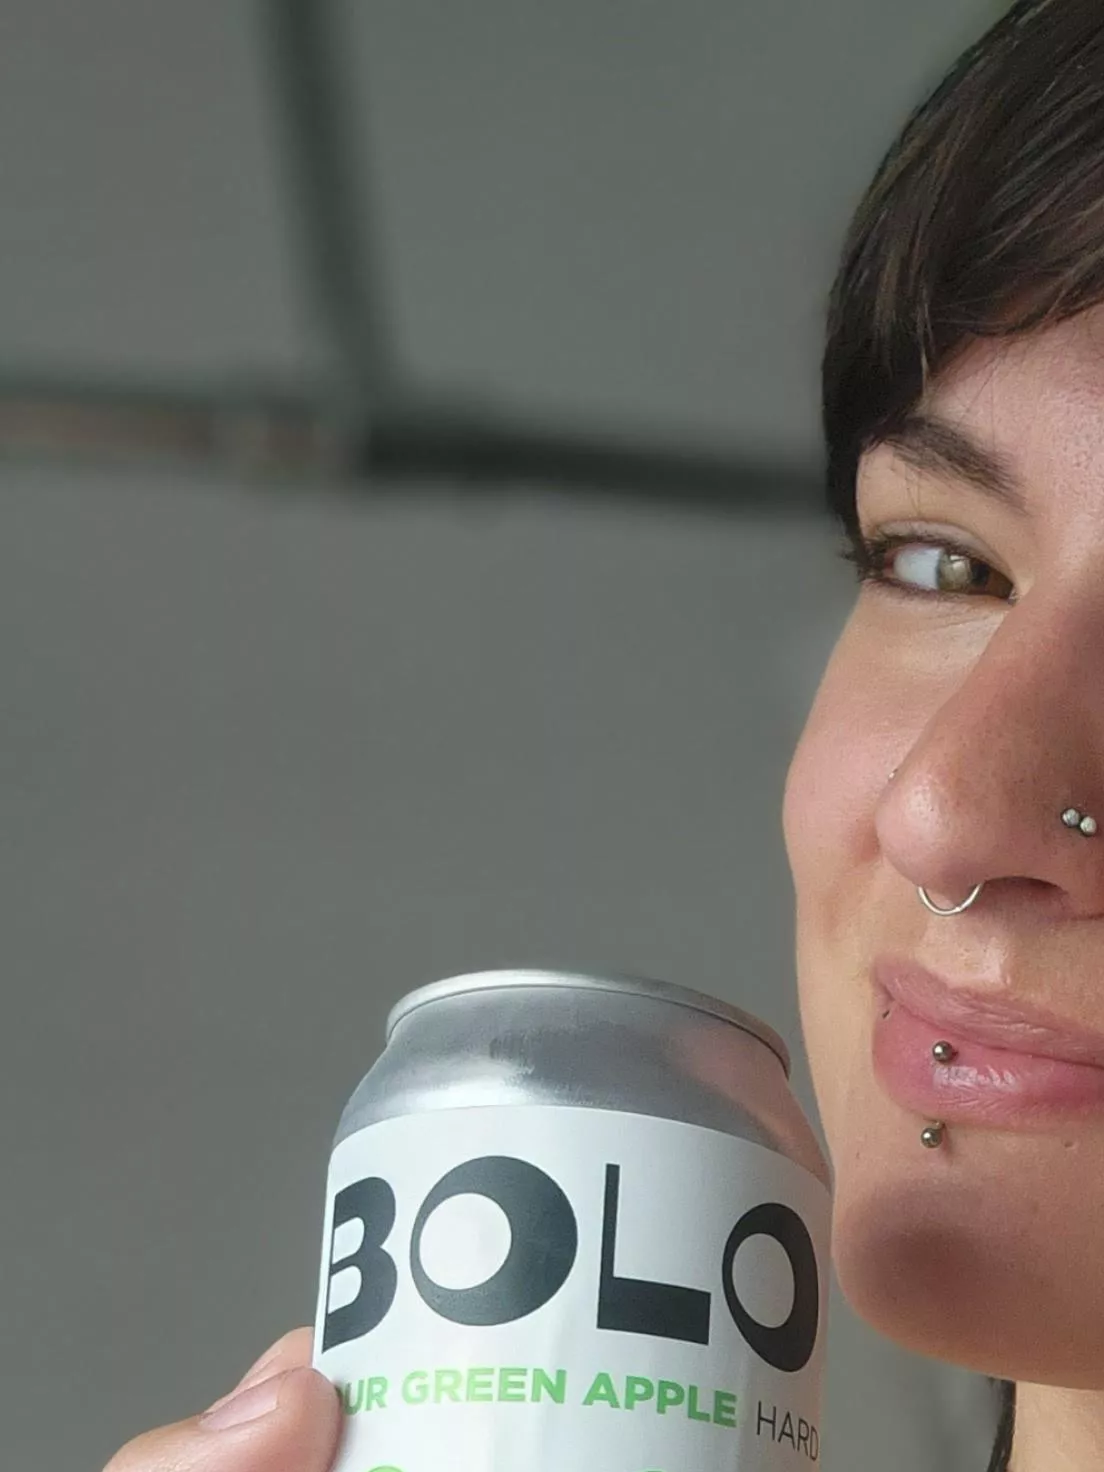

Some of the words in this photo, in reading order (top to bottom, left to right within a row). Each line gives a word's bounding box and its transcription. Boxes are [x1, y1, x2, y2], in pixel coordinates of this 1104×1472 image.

[322, 1155, 819, 1373] BOLO
[335, 1375, 389, 1416] UR
[402, 1367, 567, 1404] GREEN
[582, 1372, 738, 1428] APPLE
[756, 1399, 820, 1462] HARD
